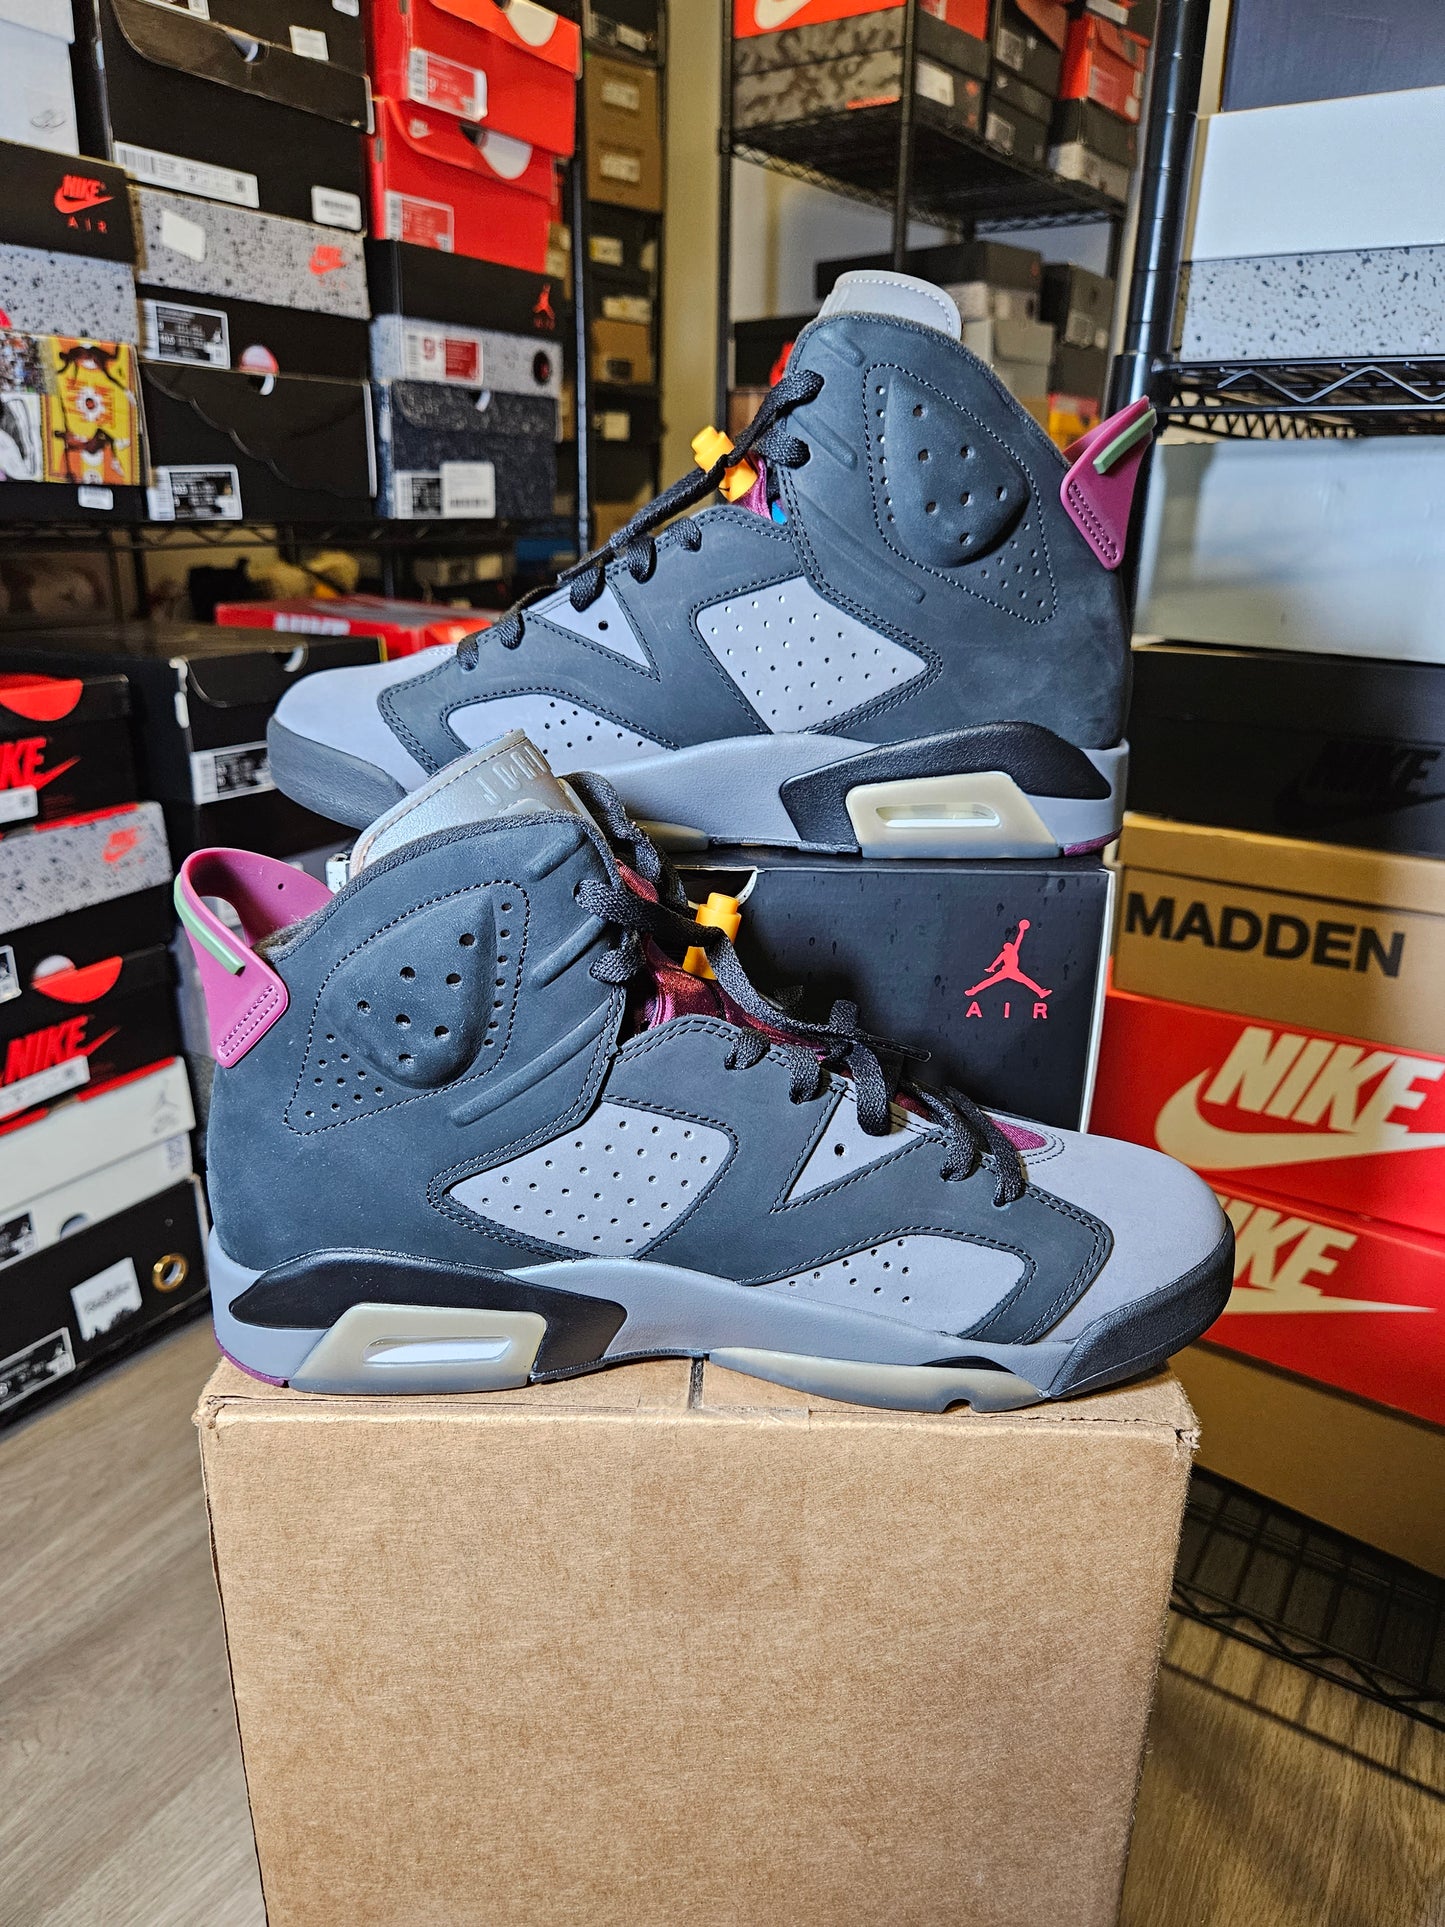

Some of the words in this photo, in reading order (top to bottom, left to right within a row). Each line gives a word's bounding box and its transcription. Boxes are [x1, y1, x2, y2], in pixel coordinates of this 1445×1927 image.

[62, 173, 103, 199] NIKE
[67, 215, 108, 234] AIR
[1125, 892, 1406, 979] MADDEN
[965, 1000, 1048, 1019] AIR
[3, 1014, 88, 1084] NIKE
[1204, 1026, 1445, 1135] NIKE
